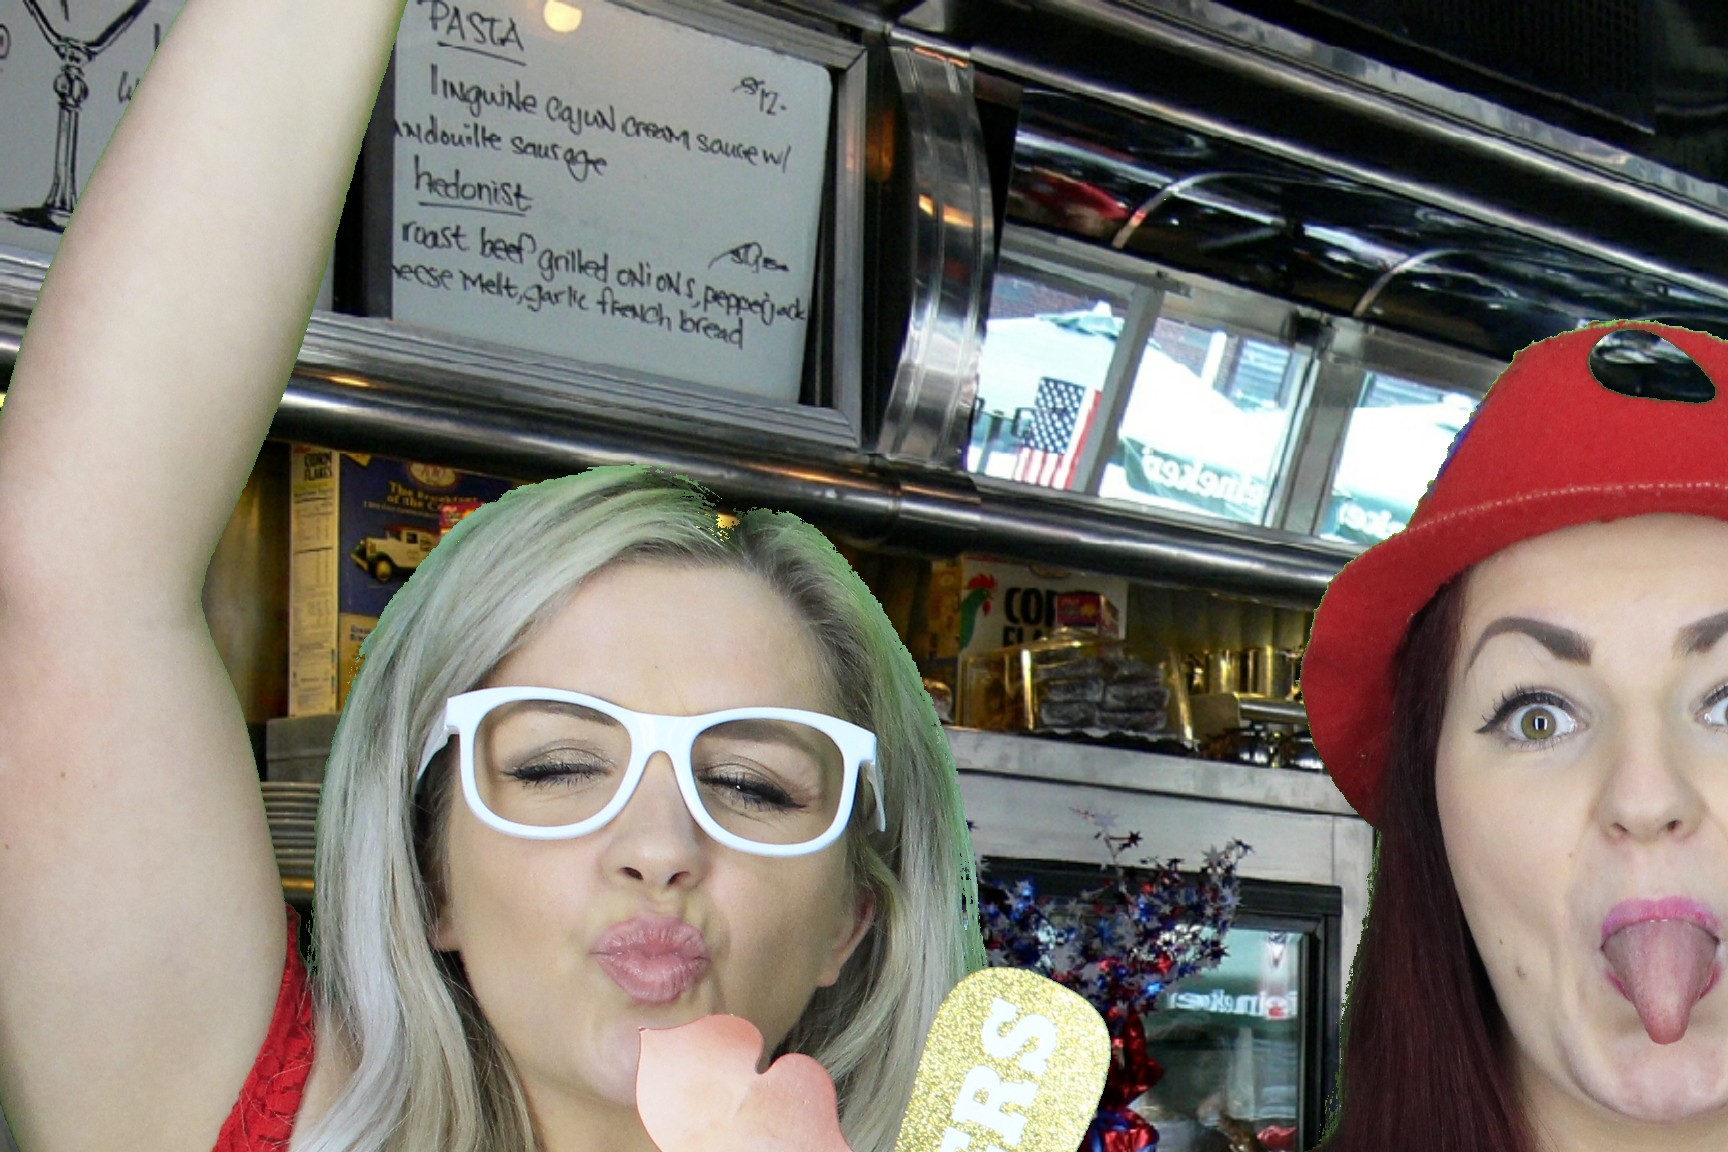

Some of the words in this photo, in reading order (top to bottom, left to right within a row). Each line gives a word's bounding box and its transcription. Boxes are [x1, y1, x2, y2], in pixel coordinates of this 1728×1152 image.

[429, 0, 525, 52] PASTA
[414, 154, 533, 212] hedonist
[402, 220, 470, 252] roast
[538, 248, 610, 284] grilled
[679, 309, 744, 351] bread
